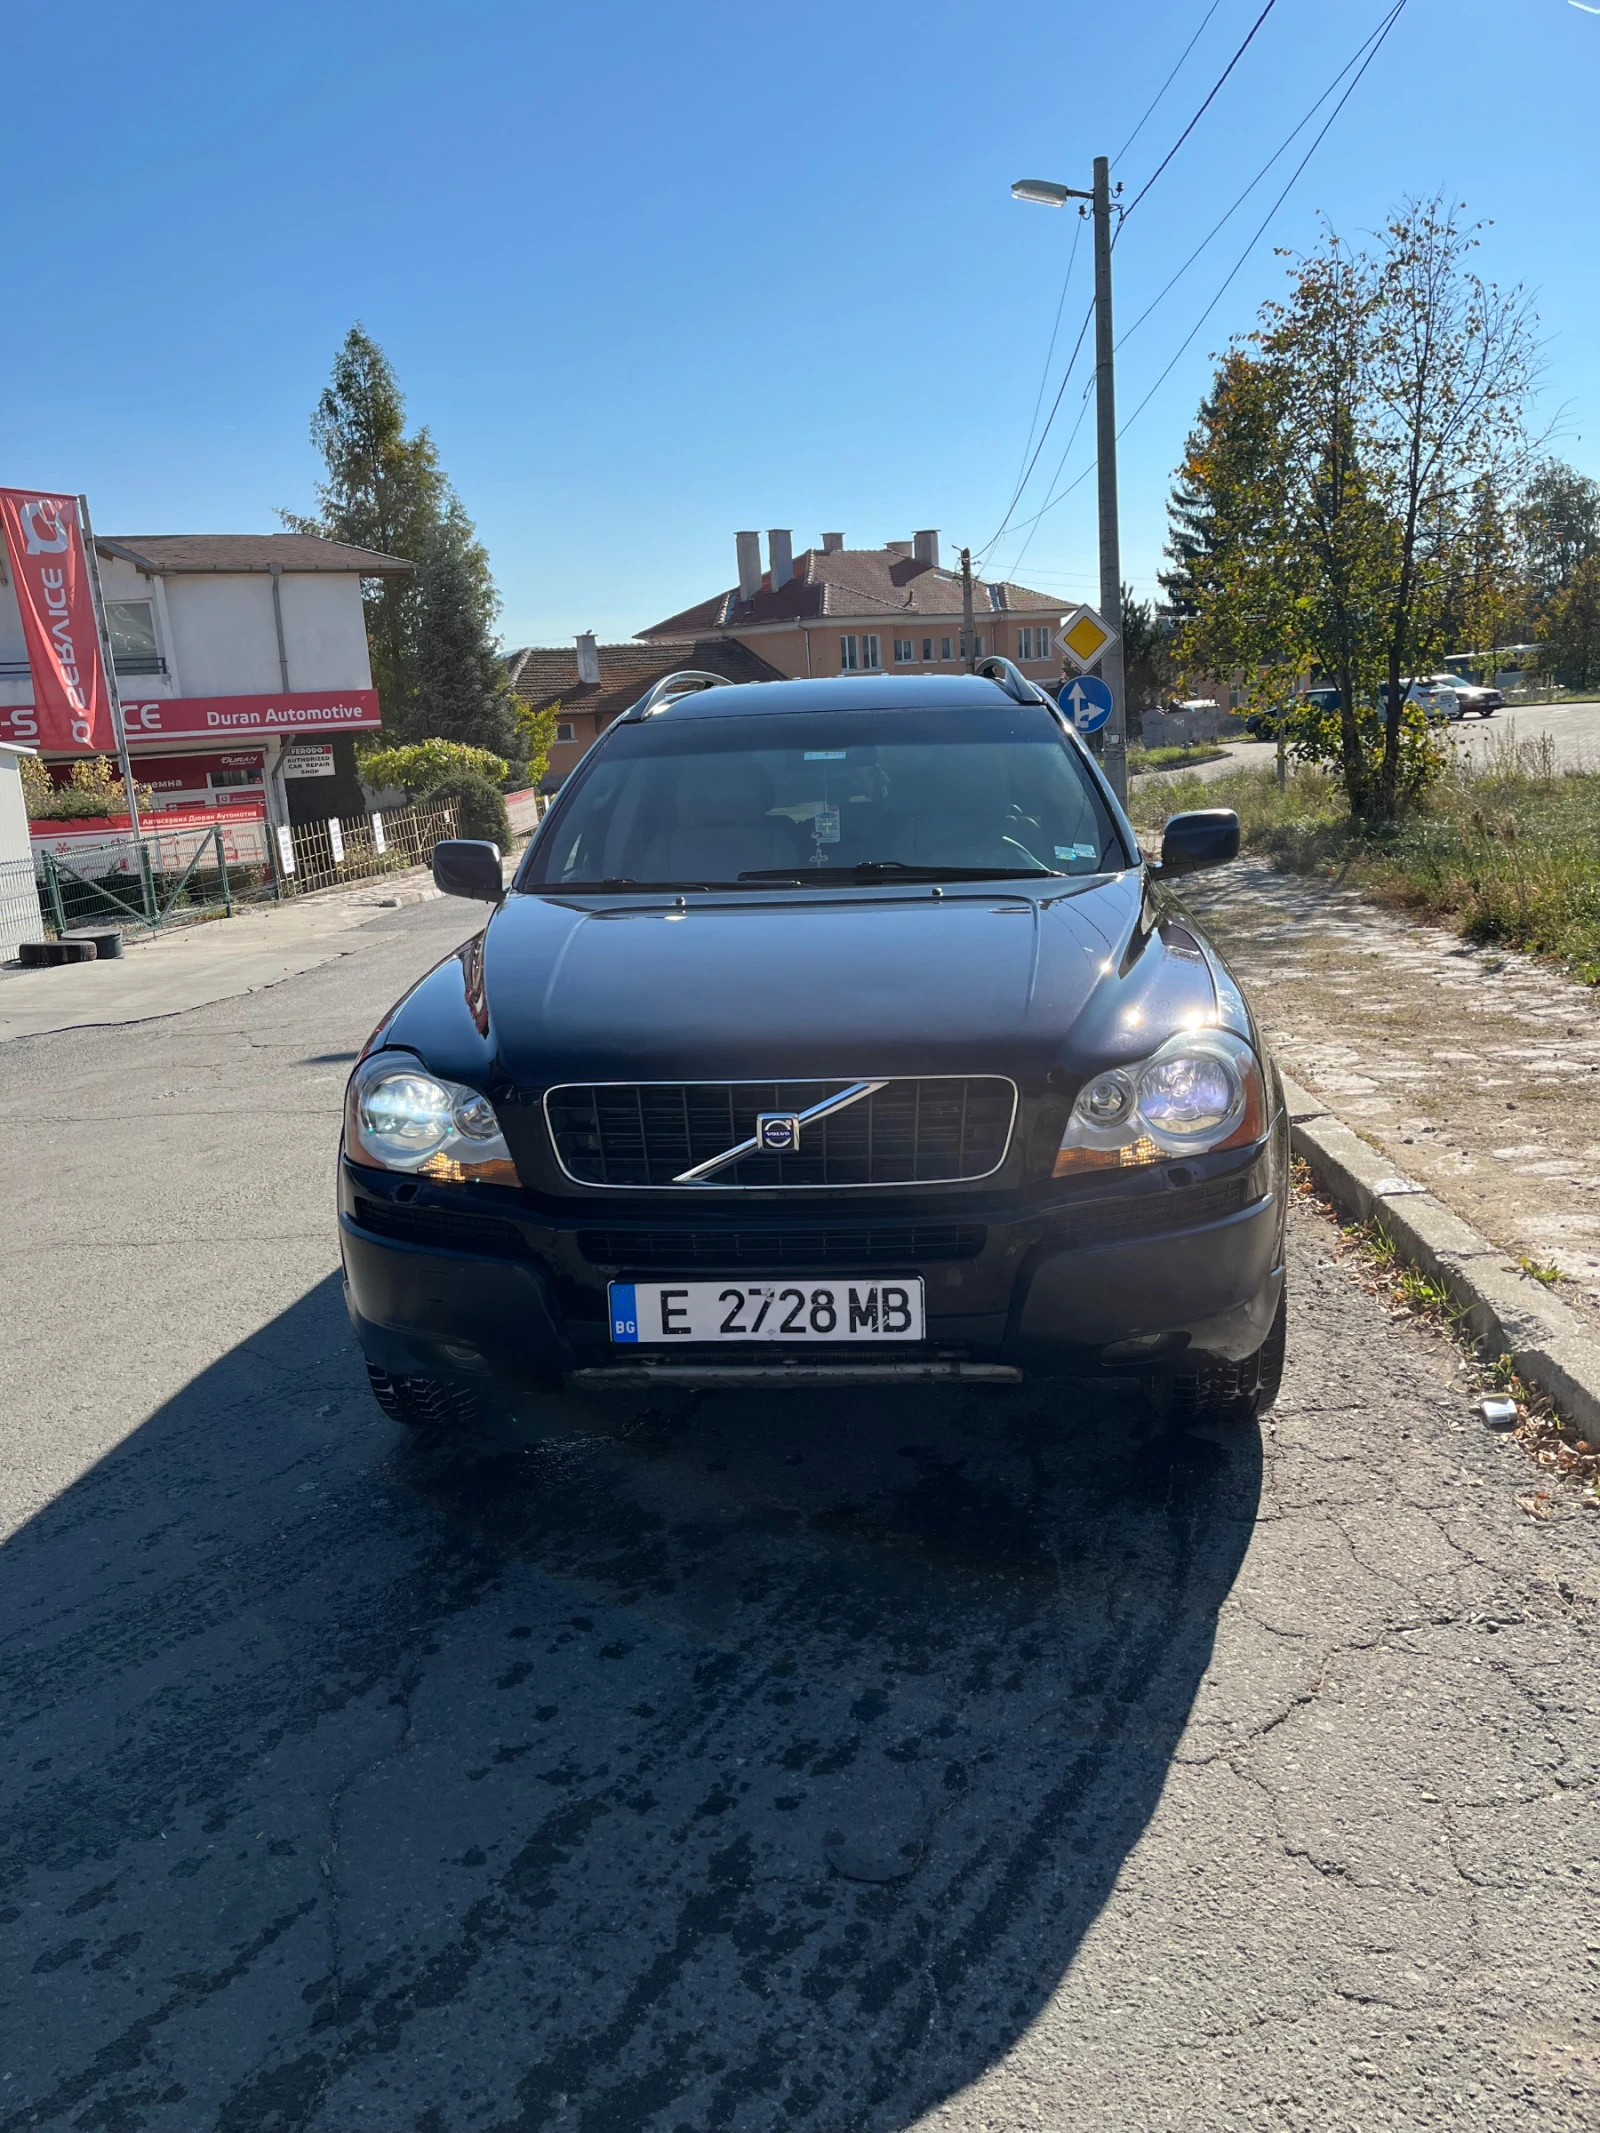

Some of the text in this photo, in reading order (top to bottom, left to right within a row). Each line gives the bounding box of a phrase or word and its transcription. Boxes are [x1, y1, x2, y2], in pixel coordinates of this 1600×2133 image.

[206, 704, 363, 726] Duran Automotive
[291, 747, 323, 755] FERODO
[220, 755, 258, 764] DURAN
[188, 814, 215, 823] Дюран
[660, 1287, 912, 1335] E 2728 MB
[615, 1321, 636, 1334] BG
